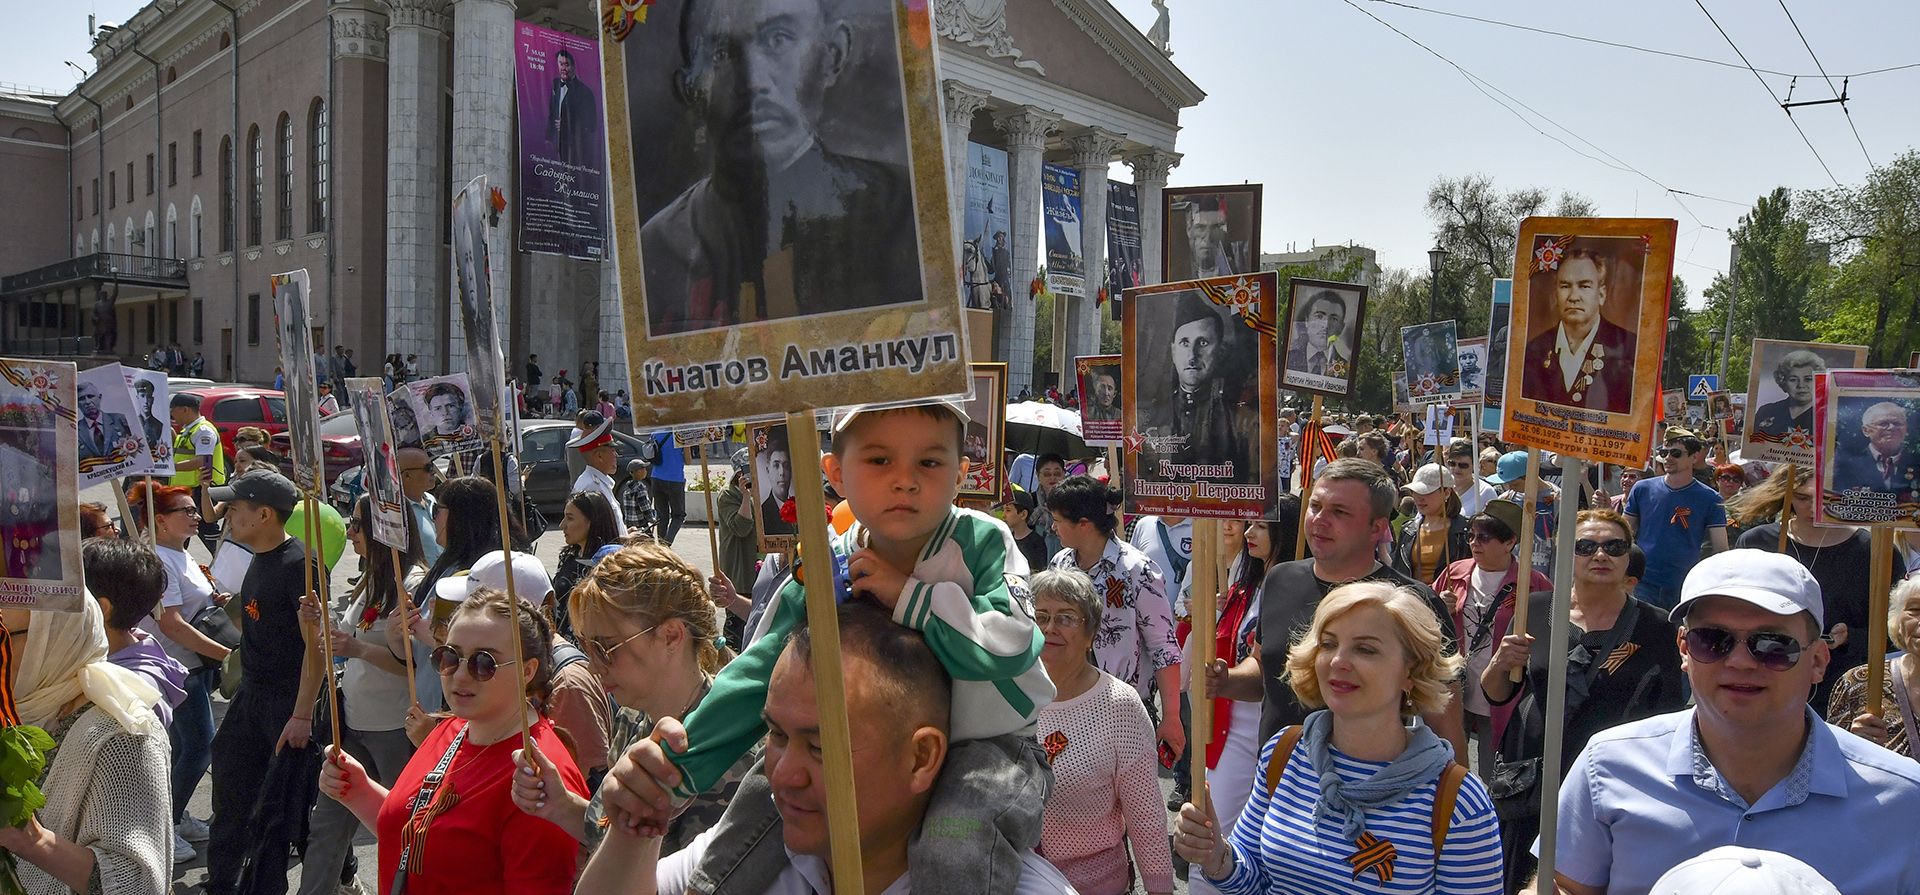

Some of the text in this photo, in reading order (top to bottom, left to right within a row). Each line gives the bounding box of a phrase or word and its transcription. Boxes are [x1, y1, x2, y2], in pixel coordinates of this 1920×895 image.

[646, 333, 957, 395] Кнатов Аманкул
[1574, 435, 1626, 451] 16.11.1997
[1159, 459, 1234, 480] Кучерявый
[1134, 480, 1265, 502] Никифор Петрович
[1843, 488, 1897, 499] Фоменко
[1831, 503, 1907, 516] Григорьевич
[1841, 496, 1897, 508] Григорий
[1139, 504, 1165, 513] Участник
[1167, 505, 1190, 514] Великой
[1192, 506, 1235, 517] Отечественной
[0, 580, 79, 596] Андреевич
